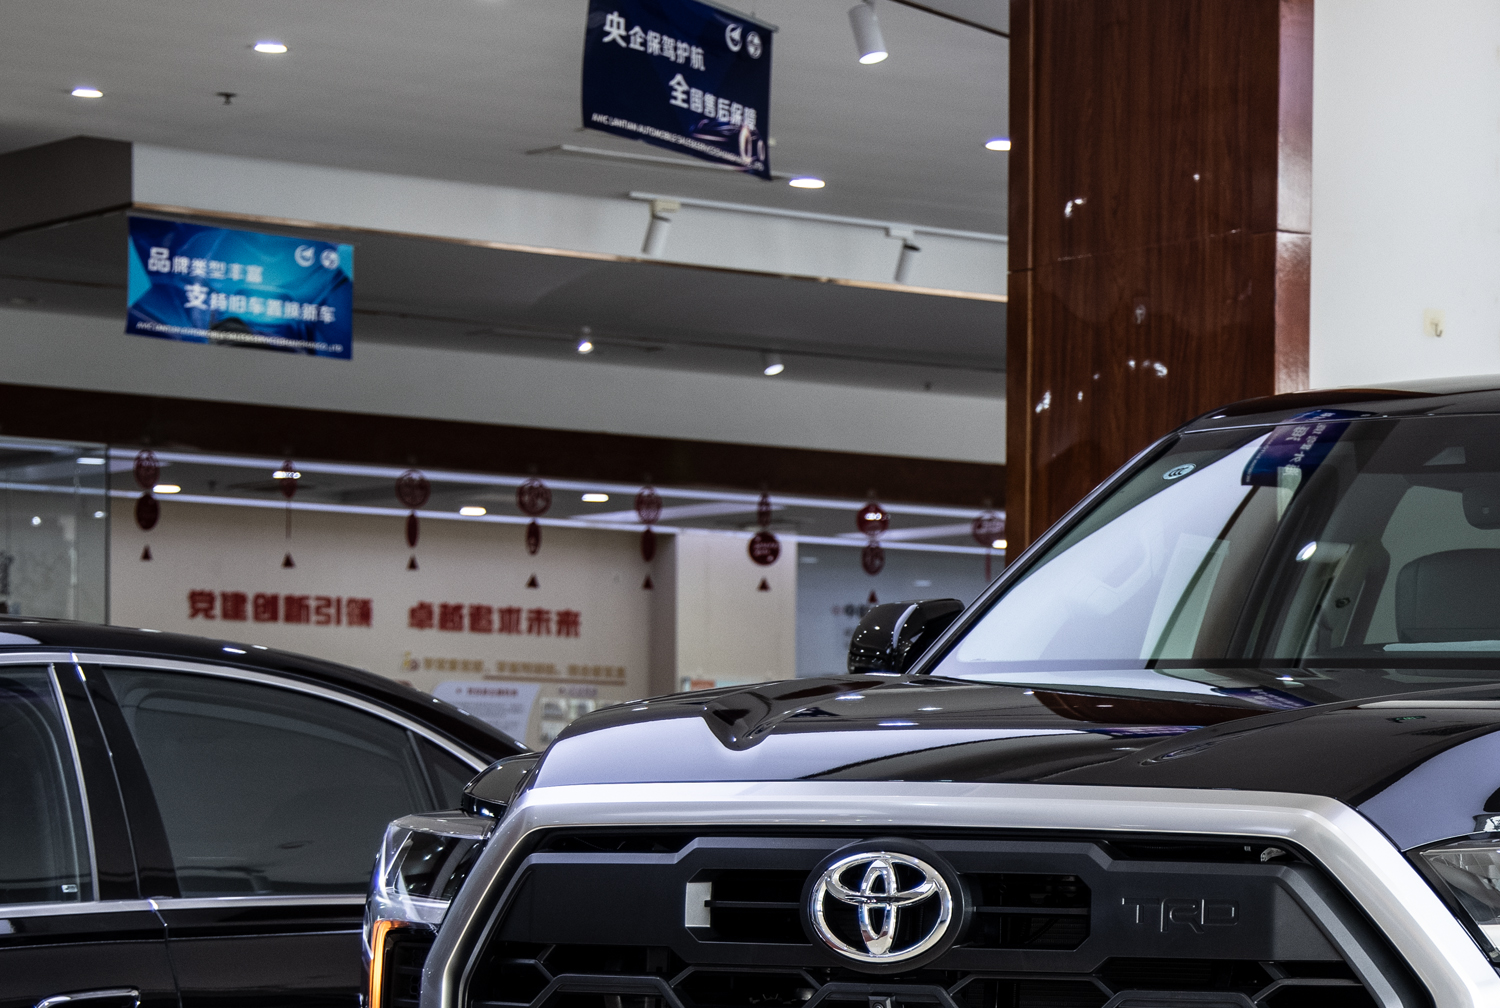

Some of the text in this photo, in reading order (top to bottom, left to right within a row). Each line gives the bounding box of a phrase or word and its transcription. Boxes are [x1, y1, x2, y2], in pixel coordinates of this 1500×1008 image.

[602, 10, 706, 71] 央企保驾护航
[669, 73, 757, 130] 全国售后保障
[1122, 897, 1239, 934] TRD
